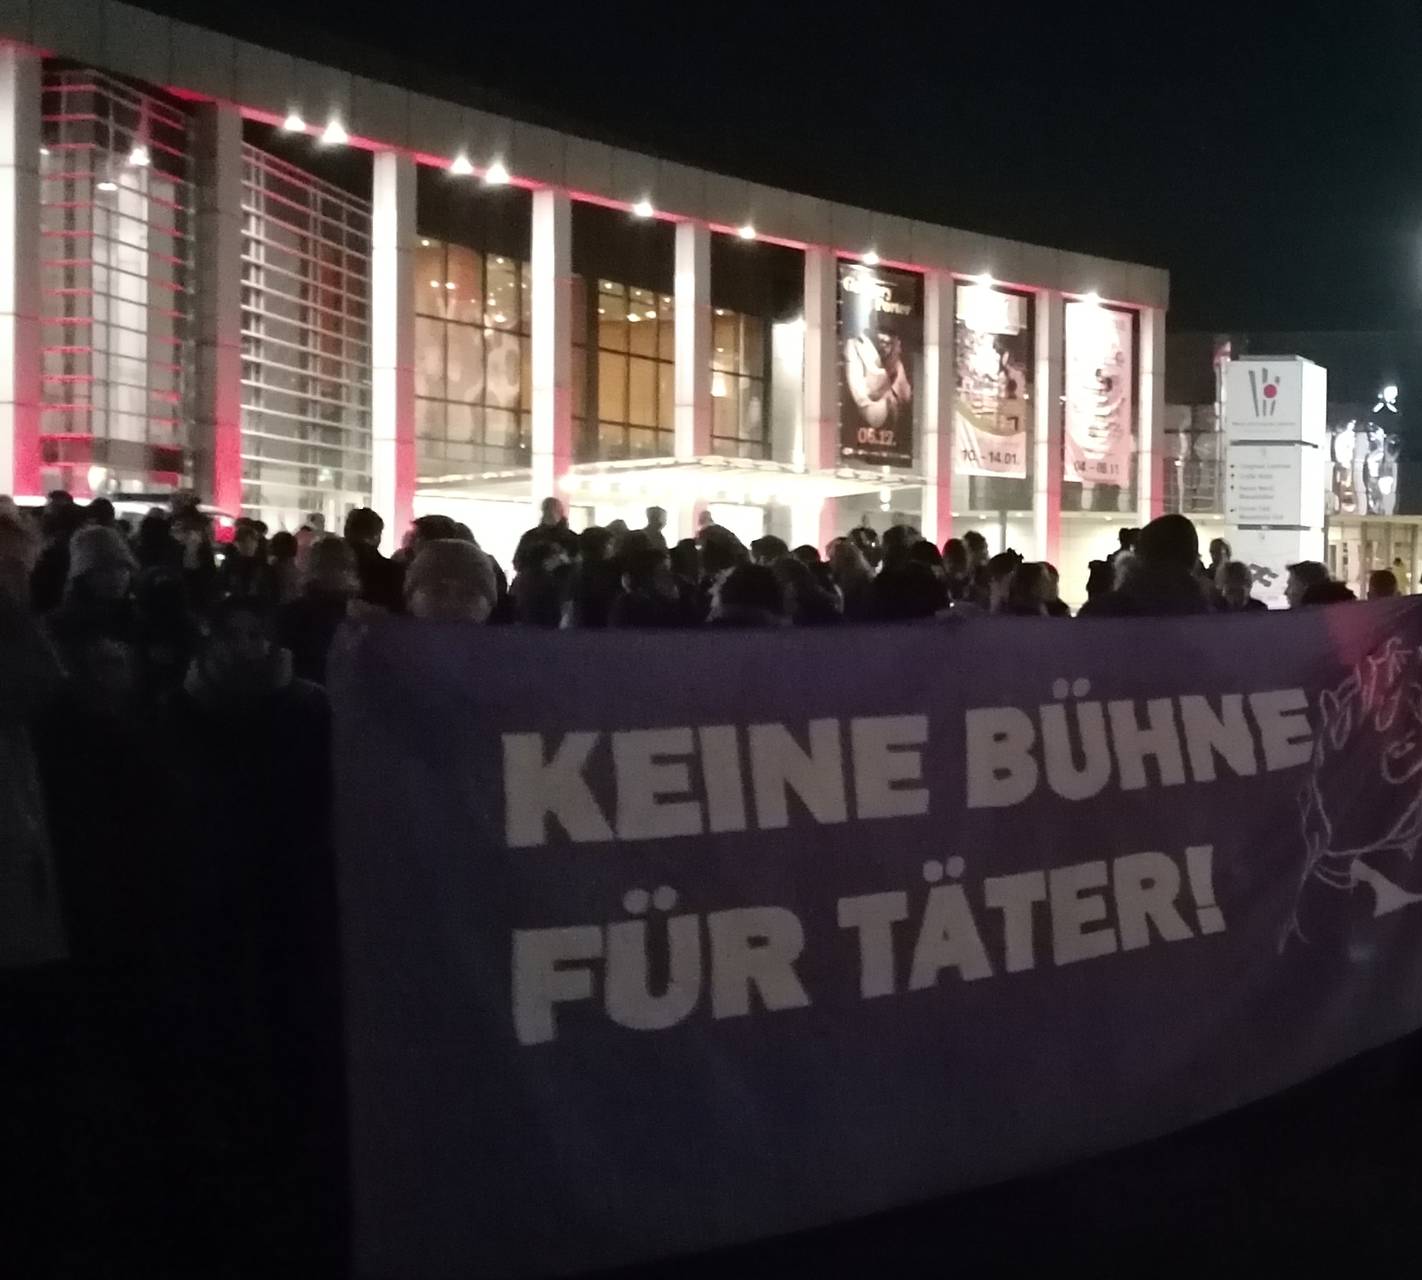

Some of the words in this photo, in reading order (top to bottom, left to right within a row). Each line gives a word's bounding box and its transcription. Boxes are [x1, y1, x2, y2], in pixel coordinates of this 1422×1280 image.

[501, 713, 930, 848] KEINE
[965, 677, 1315, 808] BÜHNE
[511, 884, 813, 1046] FÜR
[837, 844, 1227, 1000] TÄTER!
